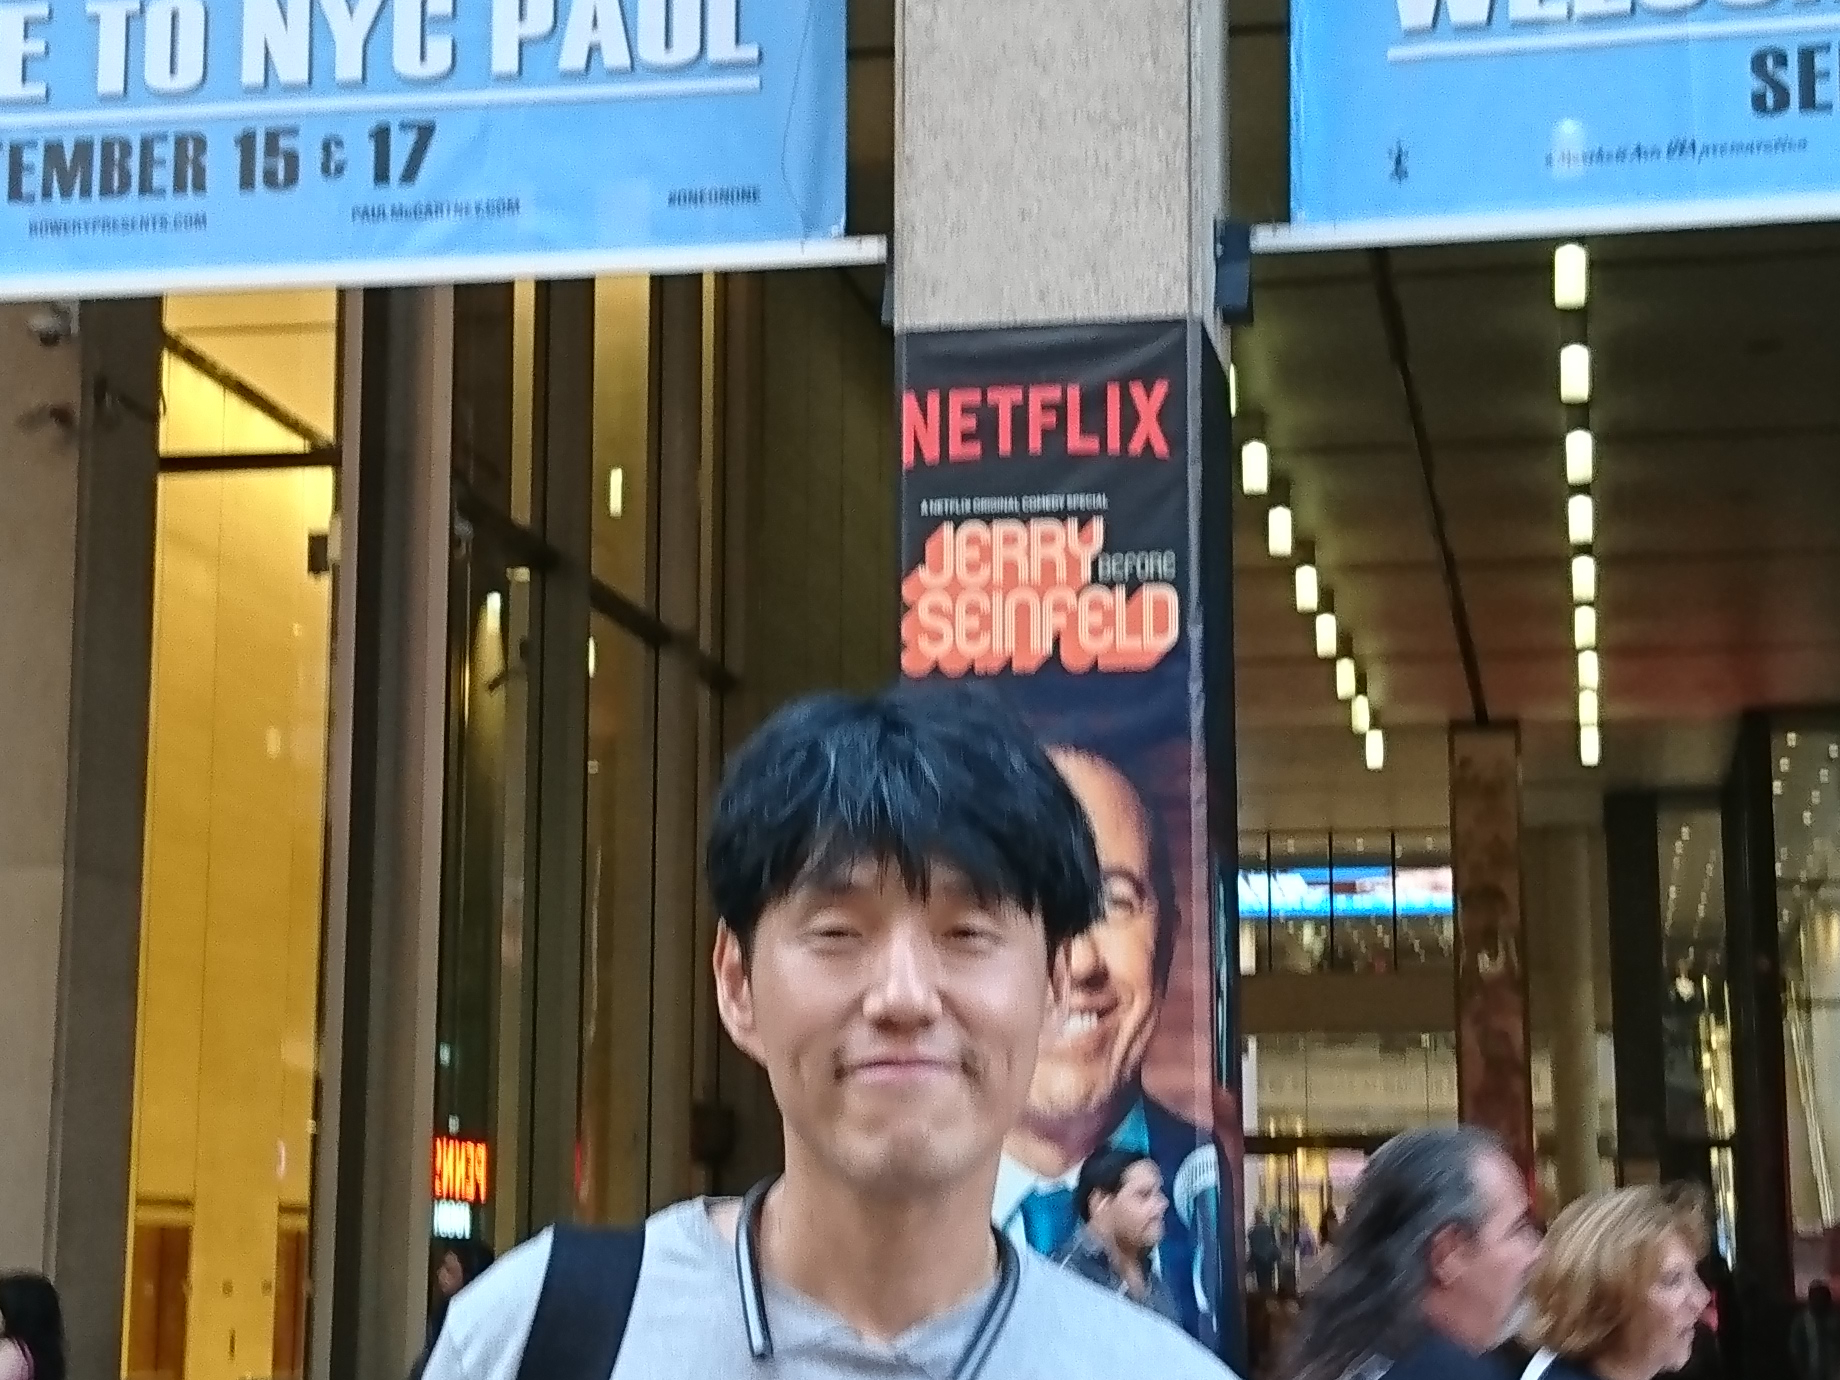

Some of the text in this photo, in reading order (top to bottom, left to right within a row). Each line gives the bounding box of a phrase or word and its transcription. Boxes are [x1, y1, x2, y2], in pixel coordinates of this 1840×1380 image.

[235, 123, 301, 194] 15
[320, 137, 348, 180] &
[369, 119, 439, 189] 17
[902, 379, 1170, 470] NETFLIX
[904, 515, 1105, 592] JERRY
[902, 581, 1180, 679] SEINFELD
